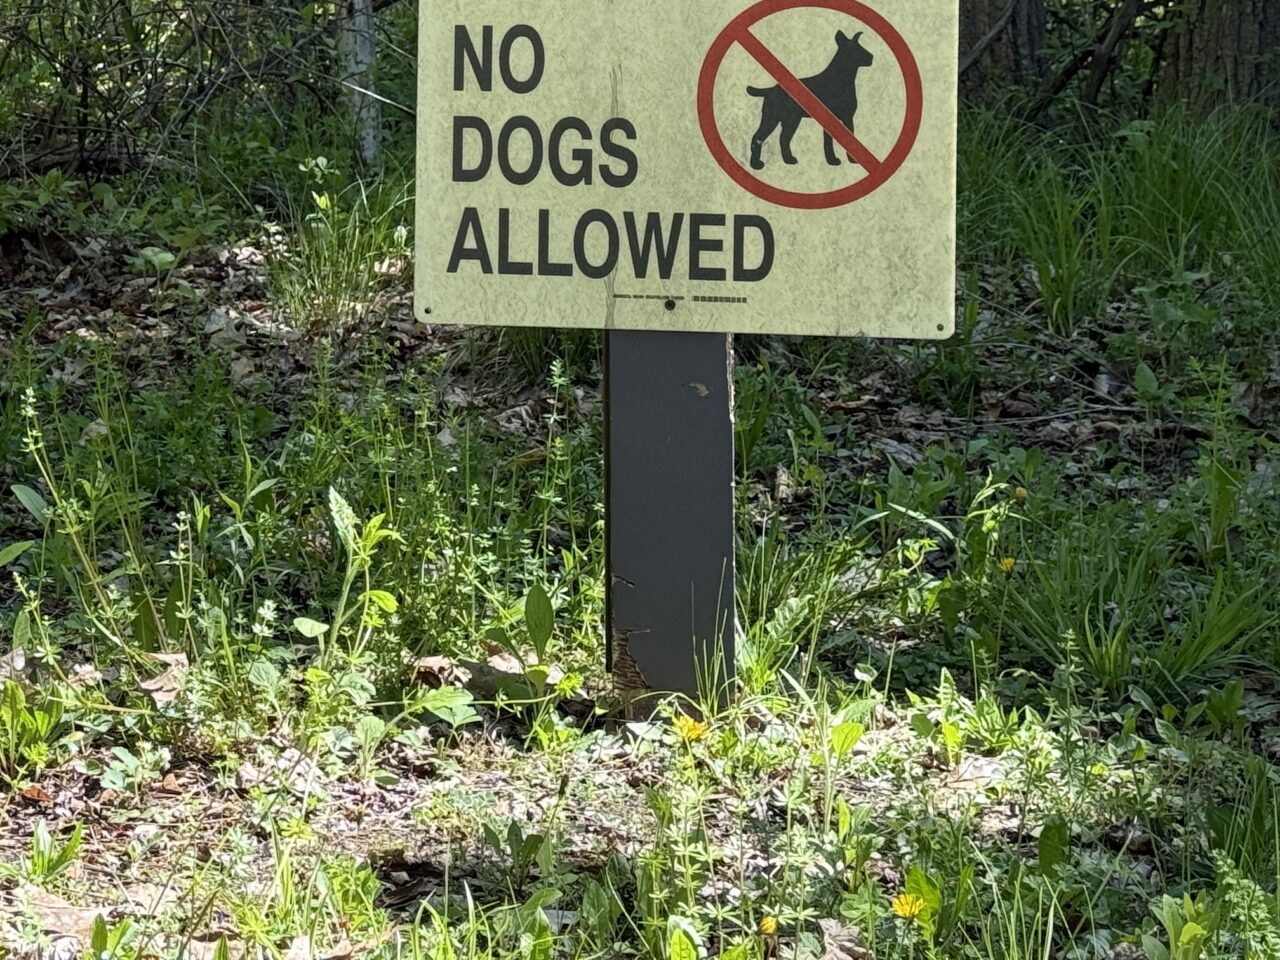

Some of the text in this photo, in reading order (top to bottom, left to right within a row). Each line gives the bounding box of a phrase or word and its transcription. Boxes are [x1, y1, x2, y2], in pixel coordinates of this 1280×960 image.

[452, 23, 546, 95] NO
[451, 115, 639, 189] DOGS
[446, 206, 776, 283] ALLOWED
